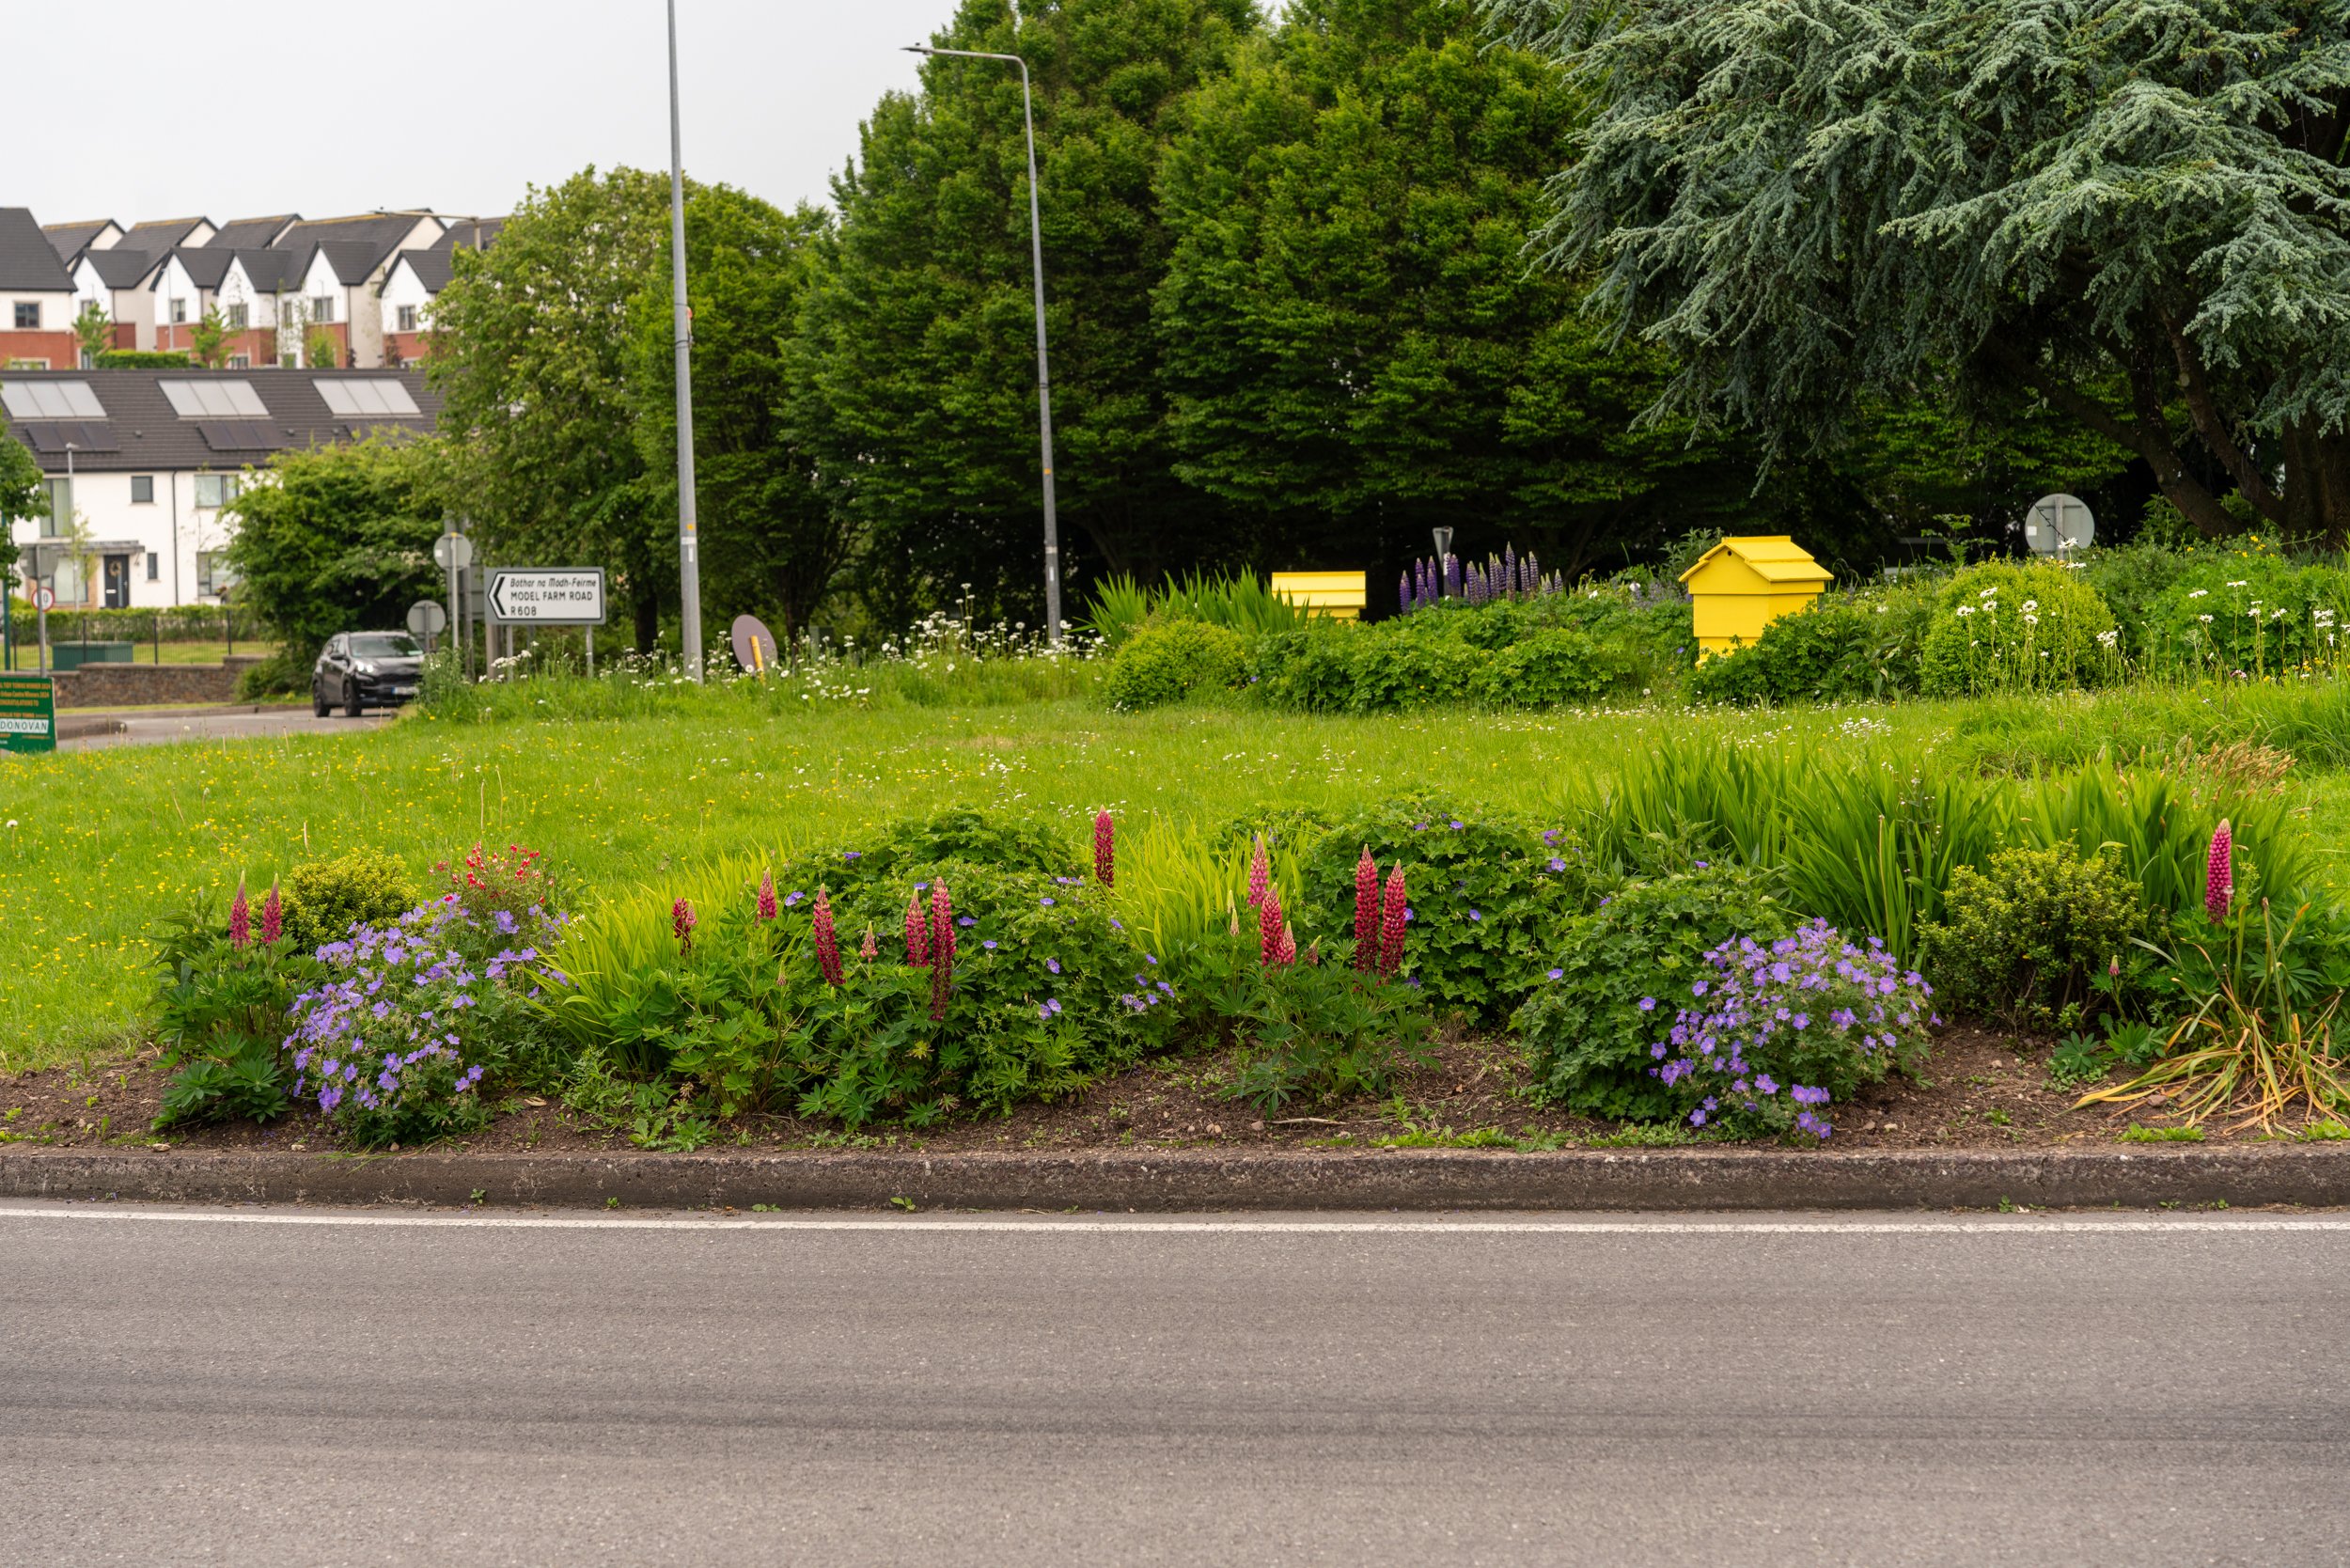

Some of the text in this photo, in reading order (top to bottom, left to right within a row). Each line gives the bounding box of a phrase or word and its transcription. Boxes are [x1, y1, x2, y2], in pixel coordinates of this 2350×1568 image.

[537, 579, 545, 588] na
[510, 591, 593, 601] MODEL FARM ROAD
[510, 605, 537, 616] R608
[0, 721, 47, 730] DONOVAN
